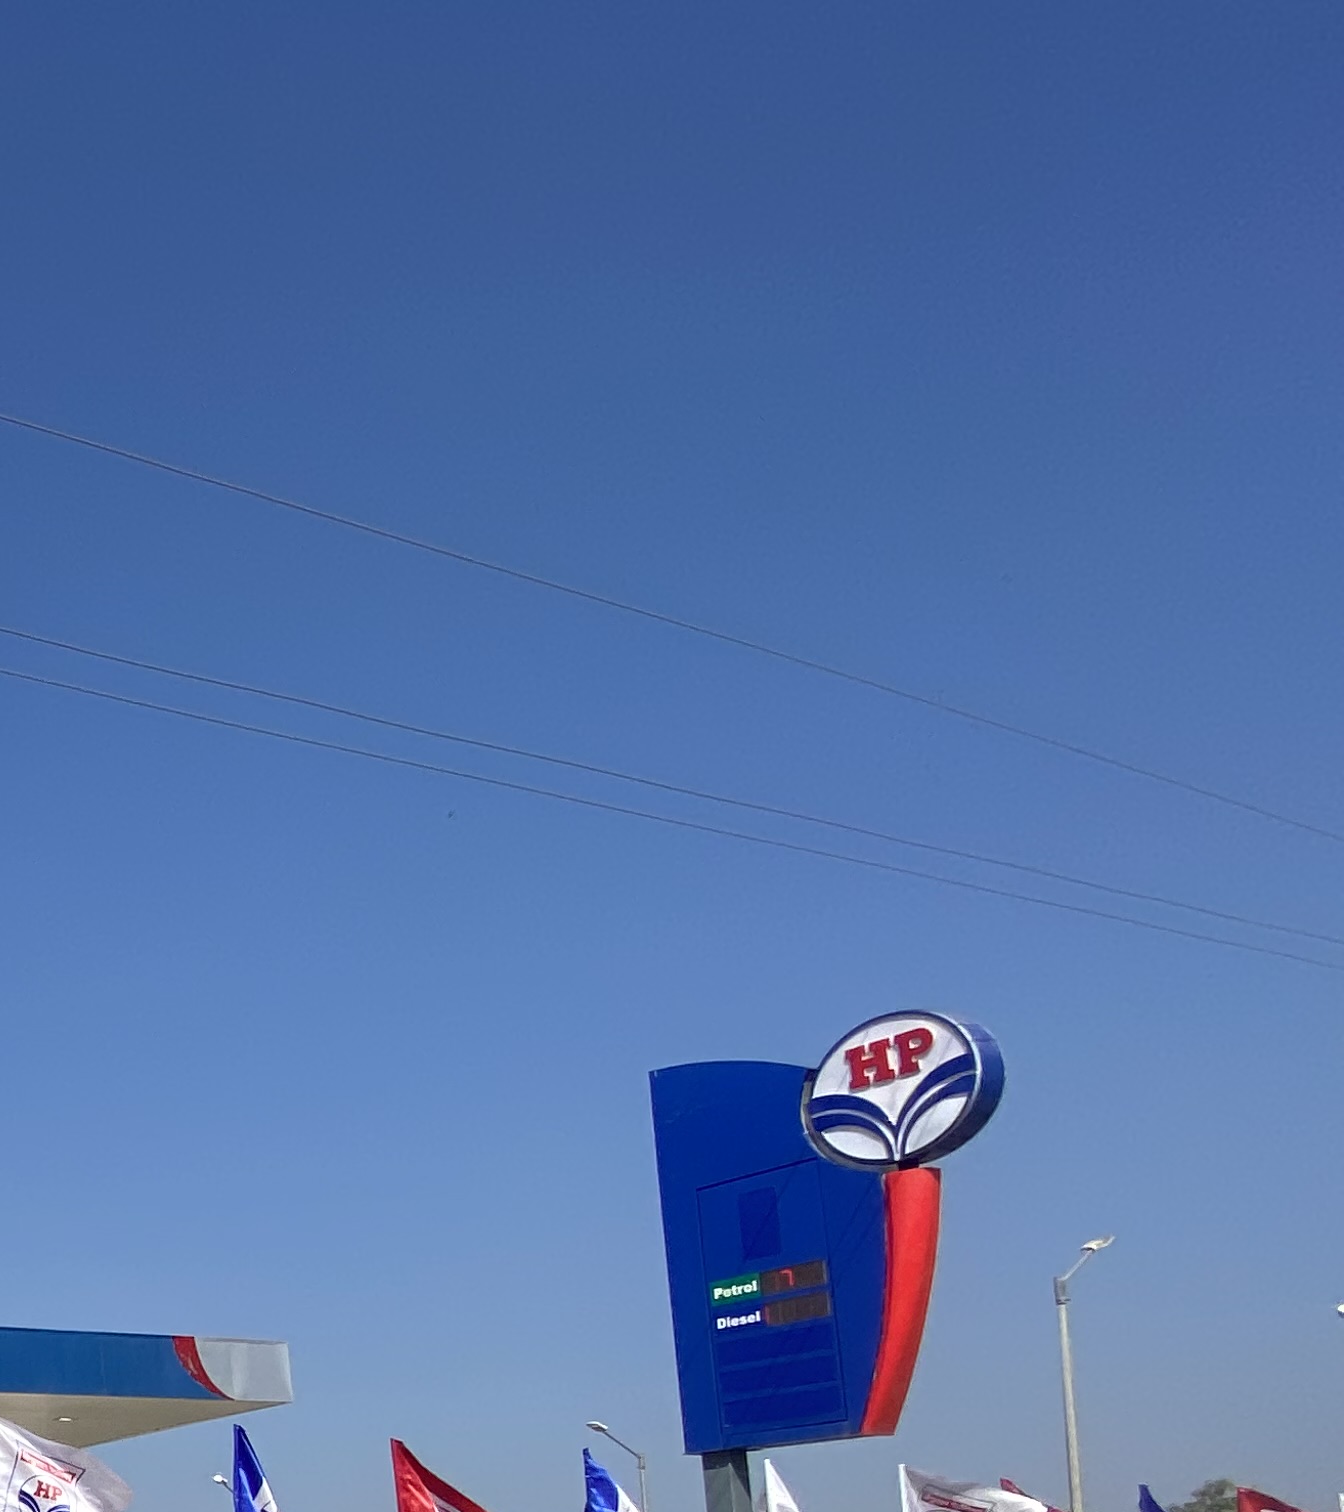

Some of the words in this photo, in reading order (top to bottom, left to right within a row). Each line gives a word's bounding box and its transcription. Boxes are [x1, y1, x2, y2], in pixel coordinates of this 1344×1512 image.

[844, 1027, 934, 1093] HP
[713, 1280, 758, 1300] Petrol
[716, 1310, 762, 1330] Diesel
[33, 1480, 63, 1501] HP
